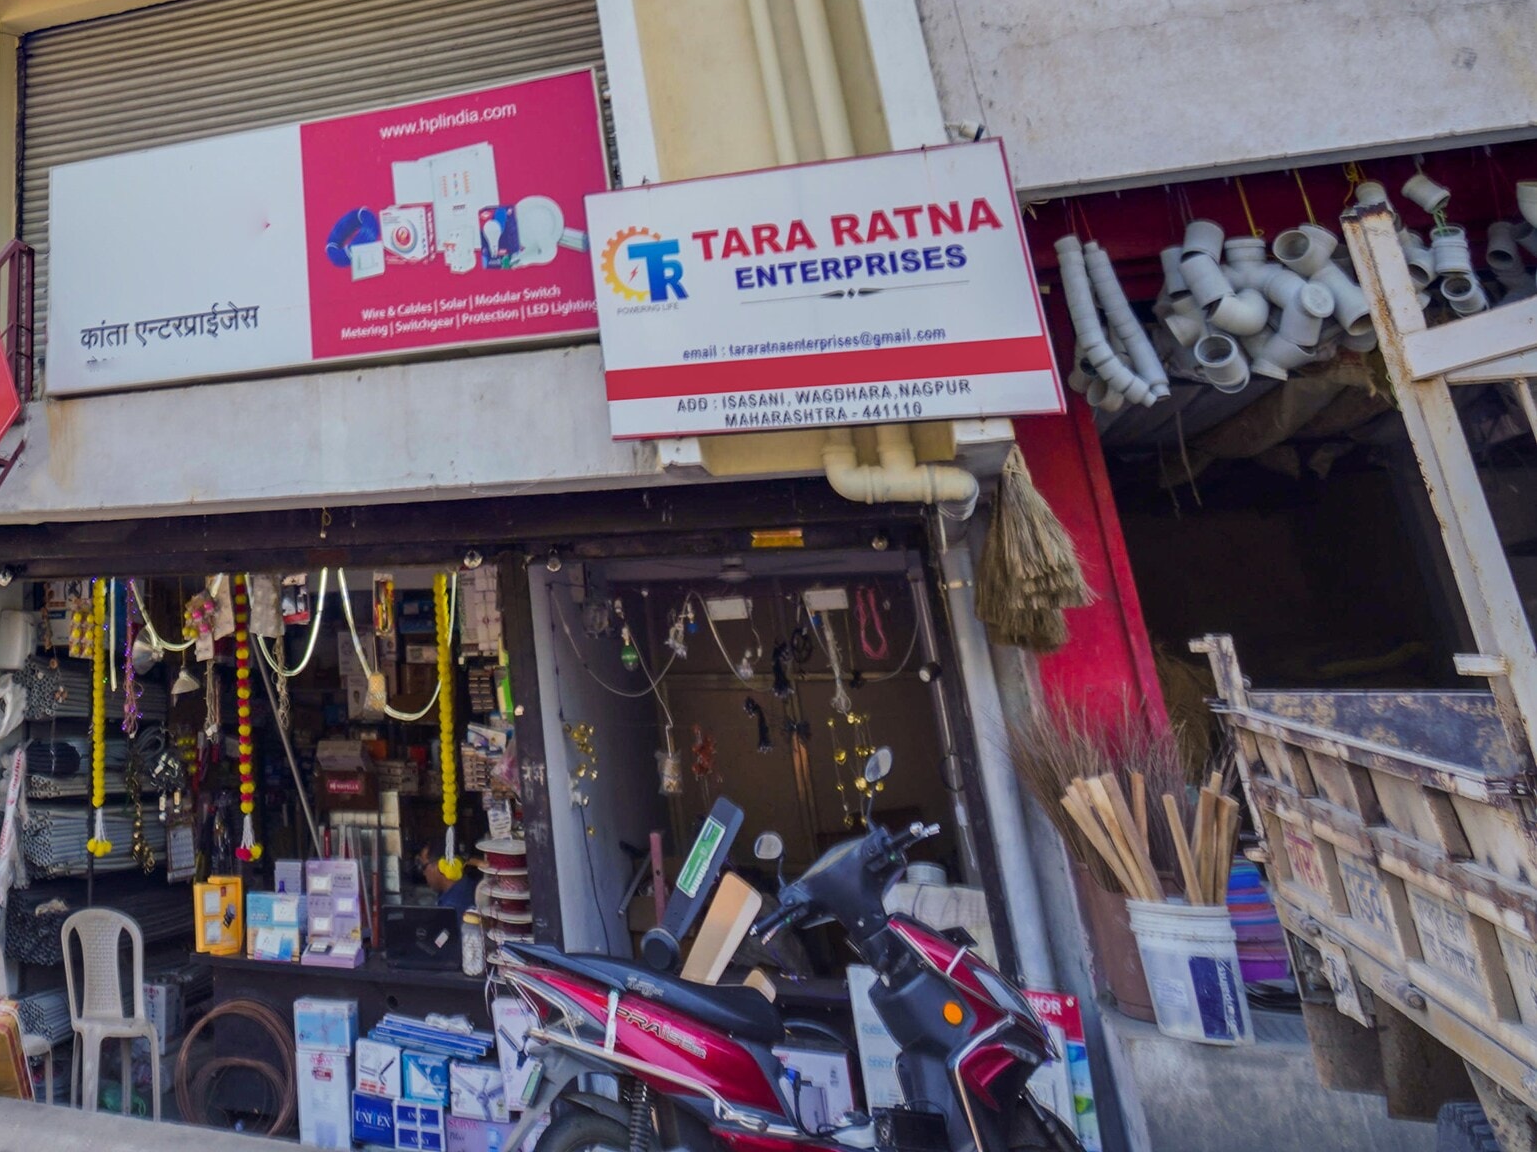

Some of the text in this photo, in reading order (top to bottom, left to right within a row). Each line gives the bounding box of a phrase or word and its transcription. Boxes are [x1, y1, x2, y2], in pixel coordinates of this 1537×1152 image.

[379, 102, 517, 140] www.hplindia.com
[692, 196, 1003, 261] TARA RATNA
[735, 243, 968, 291] ENTERPRISES
[341, 323, 389, 340] Metering
[395, 316, 454, 336] Switchgear
[461, 308, 519, 325] Protection
[526, 303, 549, 318] LED
[551, 298, 599, 317] Lighting
[361, 308, 386, 322] Wire
[396, 301, 433, 318] Cables
[439, 296, 468, 313] Solar
[474, 289, 522, 307] Modular
[522, 284, 561, 300] Switch
[662, 301, 679, 312] LIFE
[80, 320, 129, 350] कांता
[682, 345, 717, 361] email
[677, 397, 709, 413] ADD
[724, 406, 848, 428] MAHARASHTRA
[862, 401, 923, 418] 441110
